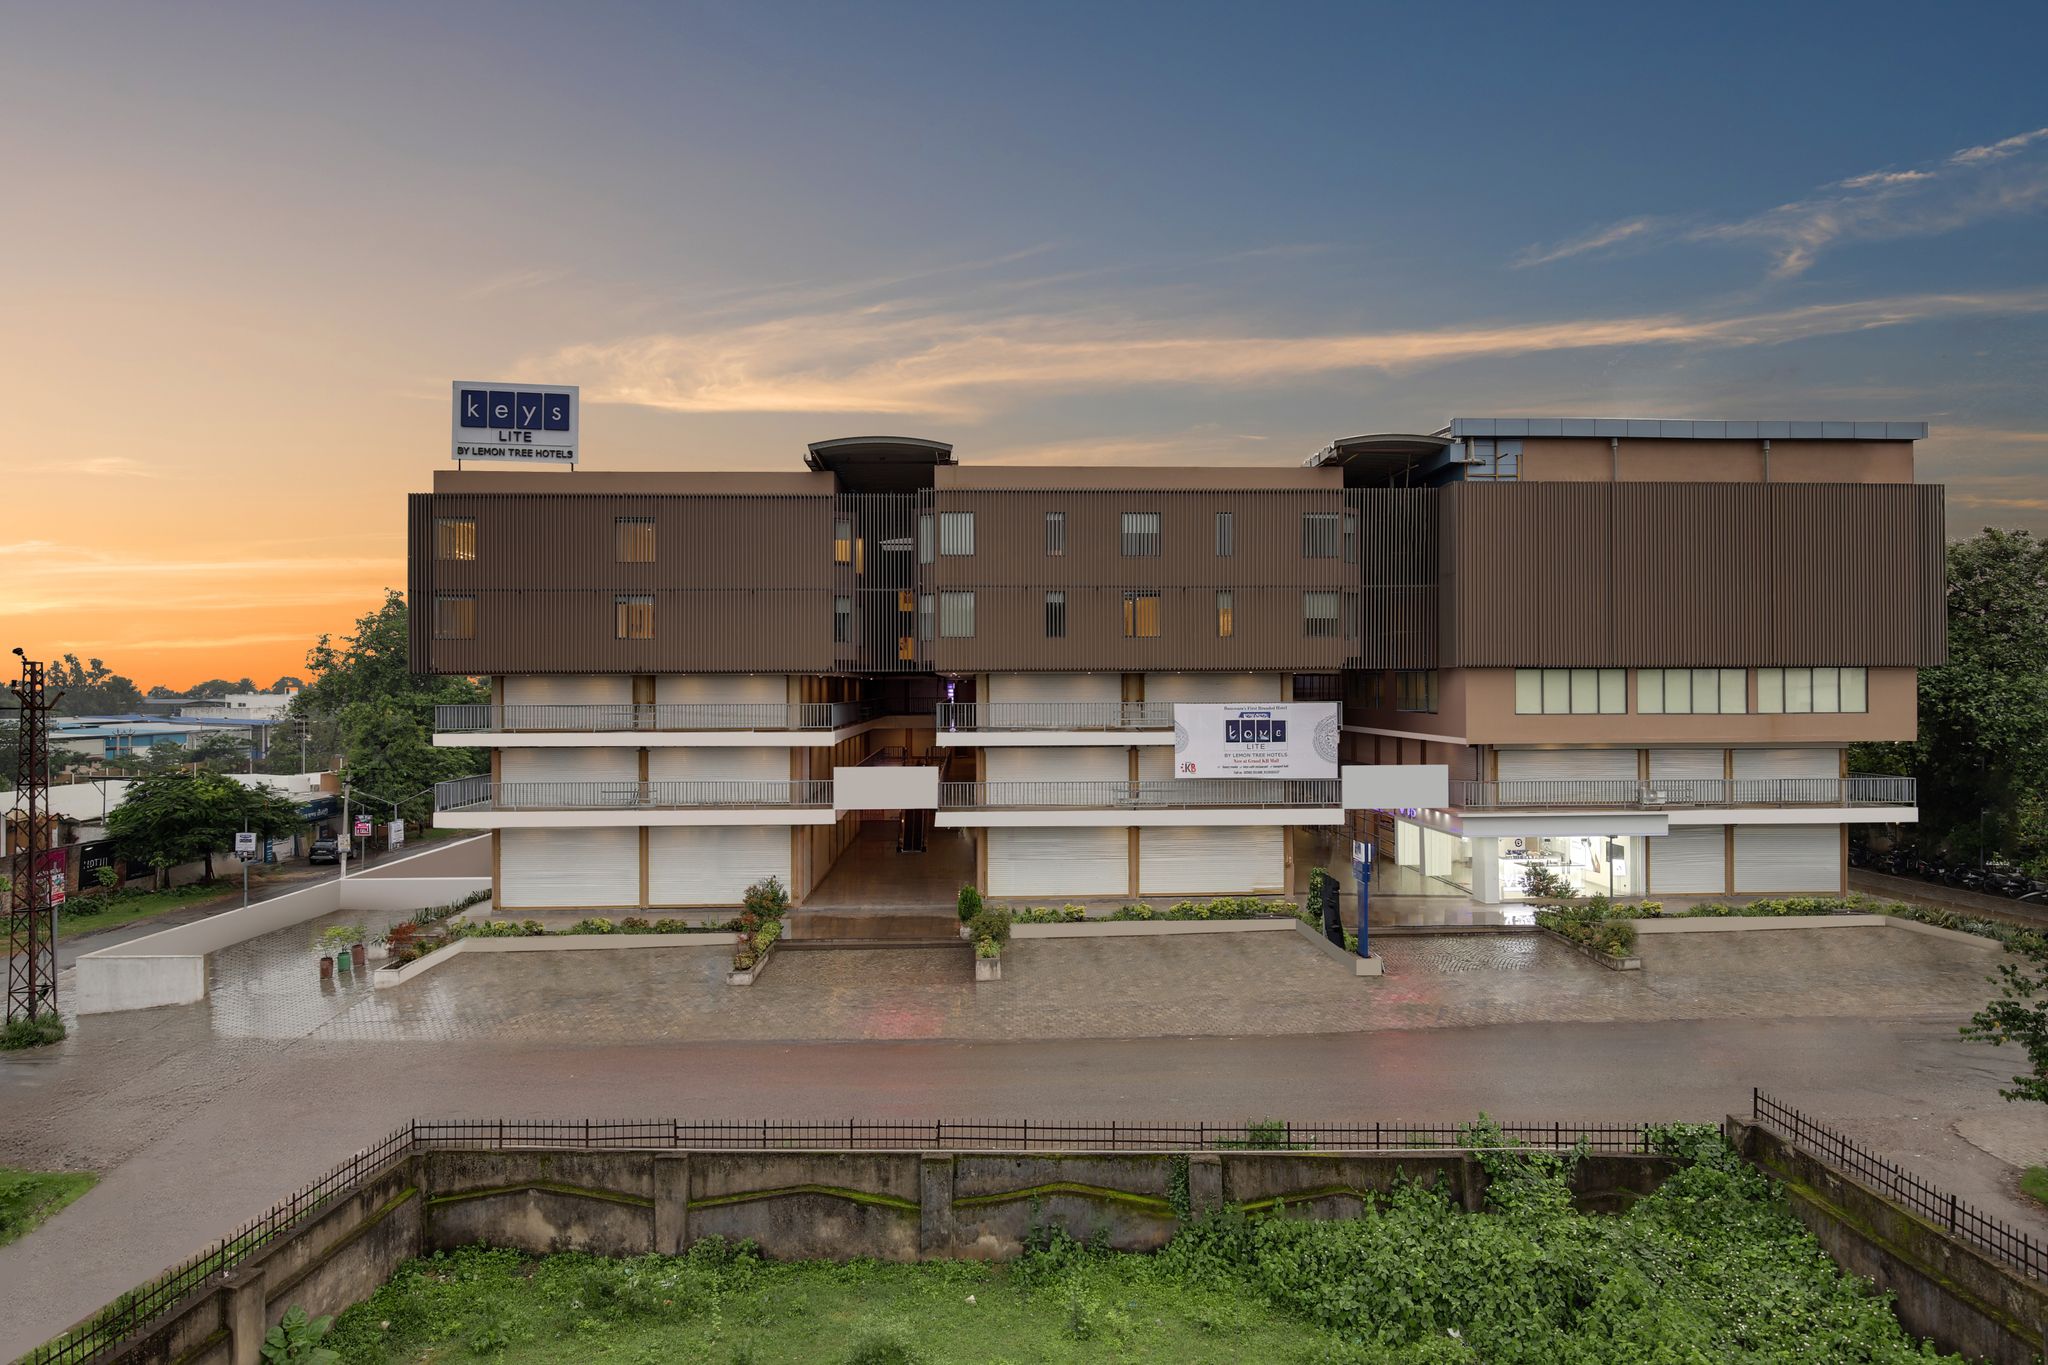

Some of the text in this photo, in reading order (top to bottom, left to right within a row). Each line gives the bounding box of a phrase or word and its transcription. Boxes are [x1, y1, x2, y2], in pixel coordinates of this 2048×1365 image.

[467, 394, 562, 426] keys
[498, 430, 532, 443] LITE
[457, 446, 573, 459] BY LEMON TREE HOTELS
